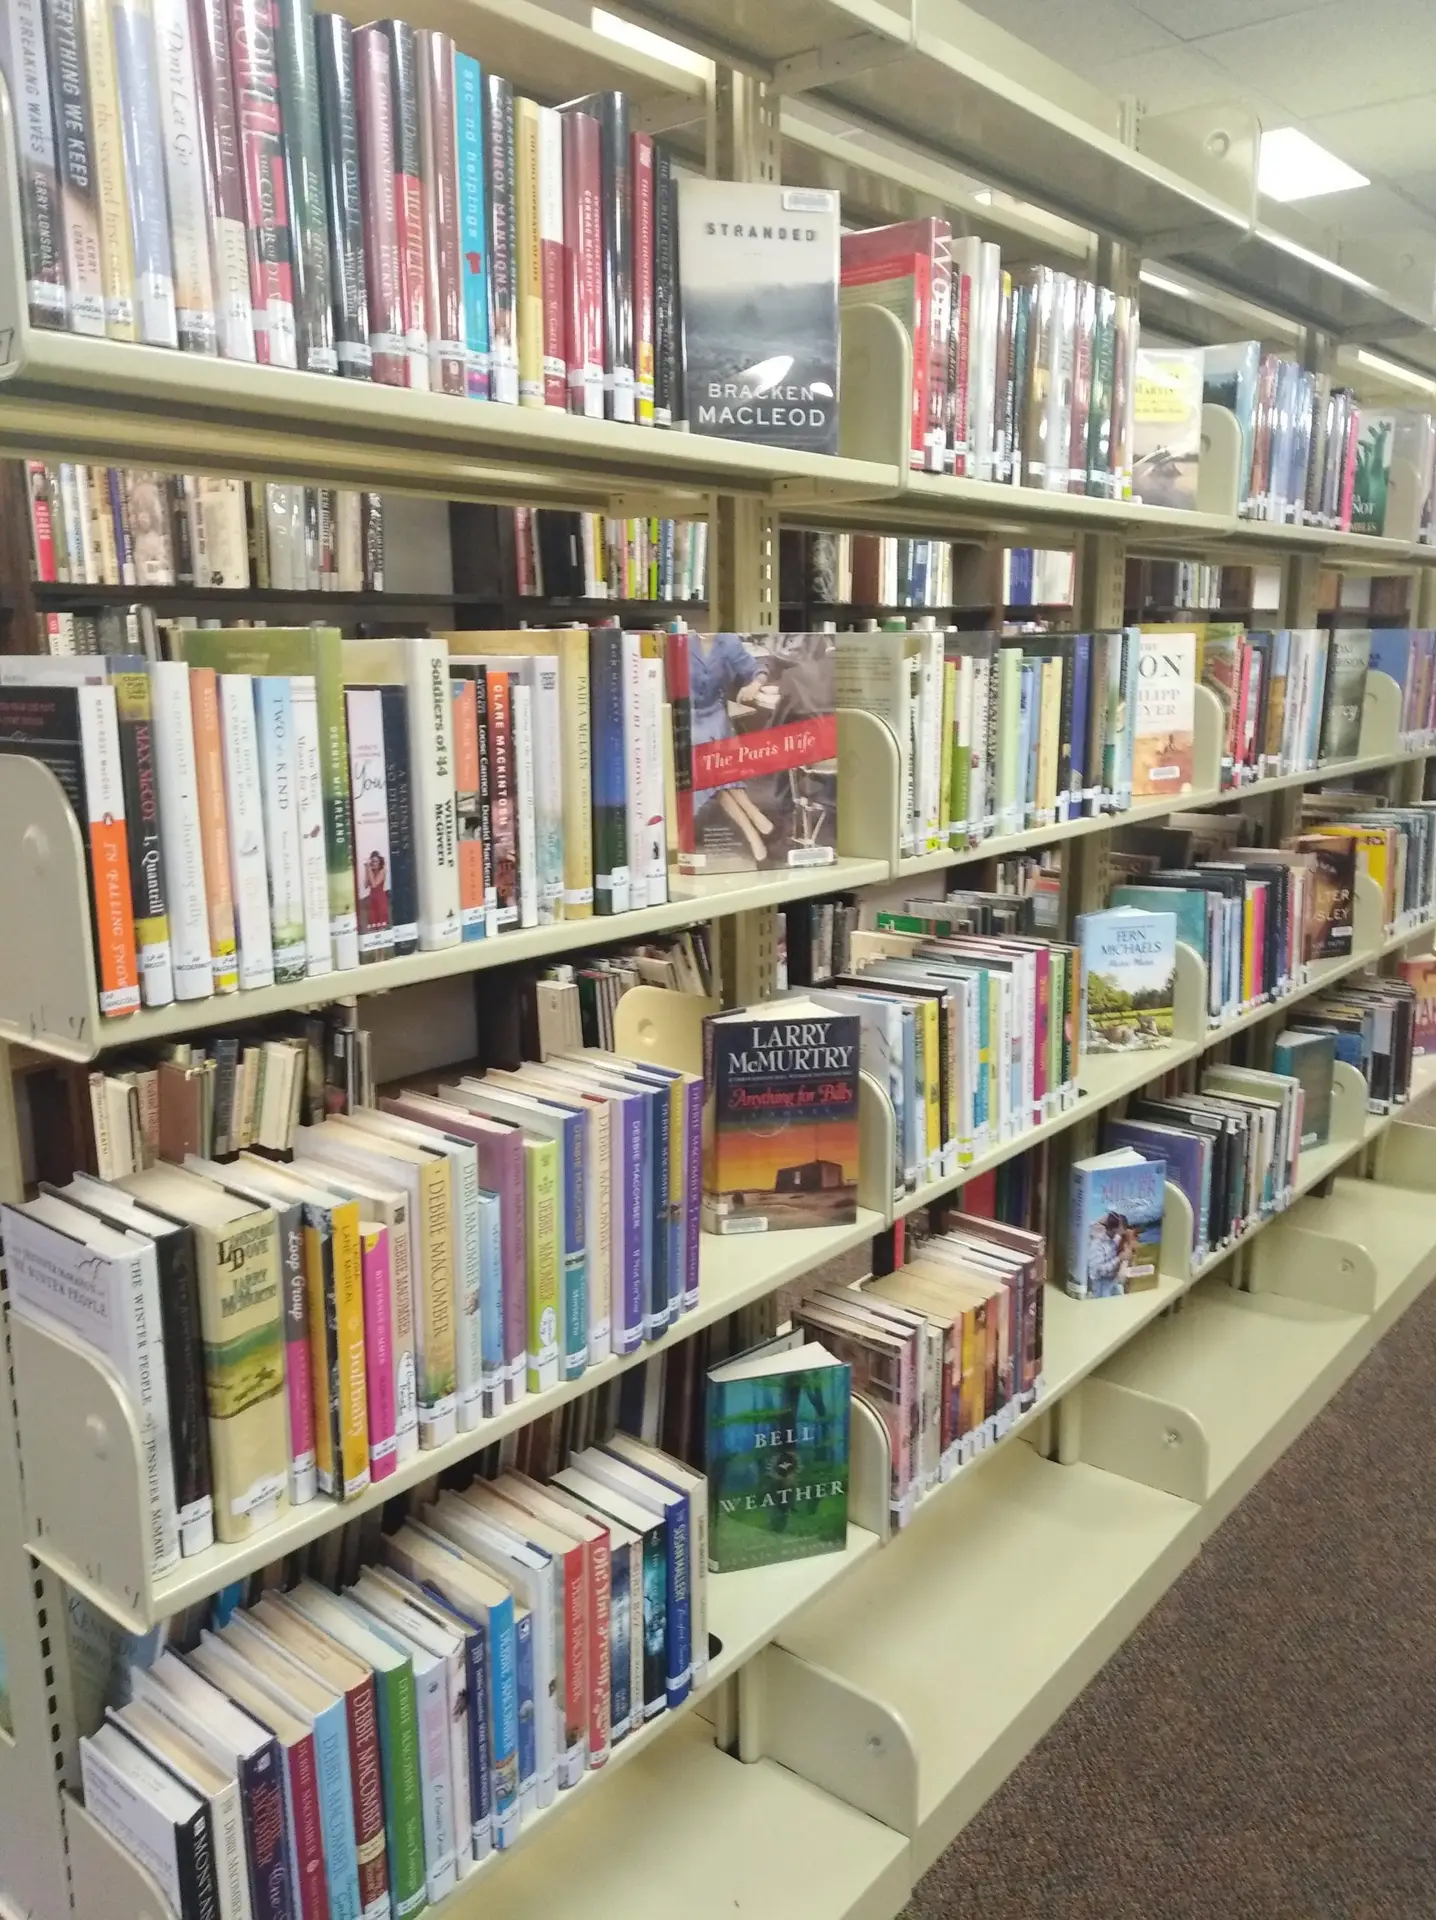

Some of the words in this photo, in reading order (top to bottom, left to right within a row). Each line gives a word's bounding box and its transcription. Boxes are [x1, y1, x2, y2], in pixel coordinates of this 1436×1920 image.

[29, 103, 44, 153] WAVES
[65, 103, 83, 131] WE
[169, 90, 191, 126] Let
[68, 137, 88, 187] KEEP
[174, 133, 193, 167] Go
[34, 171, 49, 211] KERRY
[465, 151, 481, 239] helpings
[584, 190, 593, 236] CORMAC
[493, 202, 508, 295] MANSIONS
[705, 222, 817, 243] STRANDED
[708, 383, 815, 402] BRACKEN
[698, 406, 826, 427] MACLEOD
[272, 695, 285, 739] TWO
[429, 657, 444, 731] Soldiers
[493, 684, 506, 729] CLARE
[577, 675, 588, 717] PAULA
[135, 725, 151, 765] MAX
[329, 725, 340, 773] DENNIS
[435, 734, 446, 753] of
[478, 724, 489, 755] Loose
[577, 722, 589, 771] McLAIN
[702, 752, 733, 772] The
[738, 740, 779, 764] Paris
[783, 730, 817, 754] Wife
[139, 768, 155, 822] McCOY
[275, 762, 289, 811] KIND
[480, 757, 490, 797] Cannon
[495, 735, 508, 826] MACKINTOSH
[332, 776, 345, 845] McFARLAND
[399, 783, 409, 850] MADNESS
[443, 798, 453, 854] William
[481, 804, 491, 841] Donald
[434, 803, 445, 866] McGivern
[141, 850, 165, 915] Quantrill
[1101, 941, 1161, 955] MICHAELS
[1116, 929, 1146, 942] FERN
[752, 1023, 831, 1049] LARRY
[728, 1046, 854, 1075] McMURTRY
[691, 1086, 701, 1129] DEBBIE
[729, 1086, 796, 1111] Anything
[796, 1085, 815, 1108] for
[818, 1080, 854, 1104] Billy
[572, 1123, 583, 1168] DEBBIE
[597, 1114, 610, 1166] DEBBIE
[632, 1120, 640, 1161] DEBBIE
[661, 1103, 669, 1142] DEBBIE
[462, 1163, 477, 1209] DEBBIE
[660, 1147, 668, 1207] MACOMBER
[689, 1135, 699, 1204] MACOMBER
[428, 1180, 447, 1237] DEBBIE
[537, 1197, 555, 1240] DEBBIE
[573, 1172, 584, 1244] MACOMBER
[599, 1169, 611, 1260] MACOMBER
[632, 1163, 640, 1229] MACOMBER
[286, 1231, 304, 1272] Loop
[342, 1224, 351, 1257] LANE
[394, 1235, 408, 1276] DEBBIE
[464, 1212, 478, 1289] MACOMBER
[130, 1260, 142, 1289] THE
[429, 1242, 449, 1338] MACOMBER
[538, 1240, 555, 1304] MACOMBER
[133, 1293, 146, 1349] WINTER
[289, 1275, 307, 1321] Group
[396, 1277, 411, 1338] MACOMBER
[138, 1354, 151, 1406] PEOPLE
[348, 1338, 366, 1438] Dollbaby
[754, 1426, 816, 1449] BELL
[142, 1439, 161, 1504] JENNIFER
[720, 1480, 845, 1514] WEATHER
[674, 1524, 685, 1560] SUSAN
[571, 1578, 582, 1622] DEBBIE
[675, 1559, 686, 1602] MALLERY
[632, 1602, 642, 1629] BOX
[499, 1630, 512, 1678] DEBBIE
[572, 1627, 583, 1703] MACOMBER
[352, 1688, 375, 1749] DEBBIE
[397, 1677, 409, 1725] DEBBIE
[501, 1680, 515, 1754] MACOMBER
[297, 1740, 311, 1785] DEBBIE
[322, 1733, 340, 1787] DEBBIE
[401, 1729, 414, 1804] MACOMBER
[357, 1749, 384, 1845] MACOMBER
[223, 1820, 239, 1856] DEBBIE
[252, 1782, 273, 1868] MACOMBER
[303, 1788, 316, 1857] MACOMBER
[328, 1788, 349, 1881] MACOMBER
[228, 1857, 242, 1917] MACOMBER
[269, 1862, 285, 1908] One
